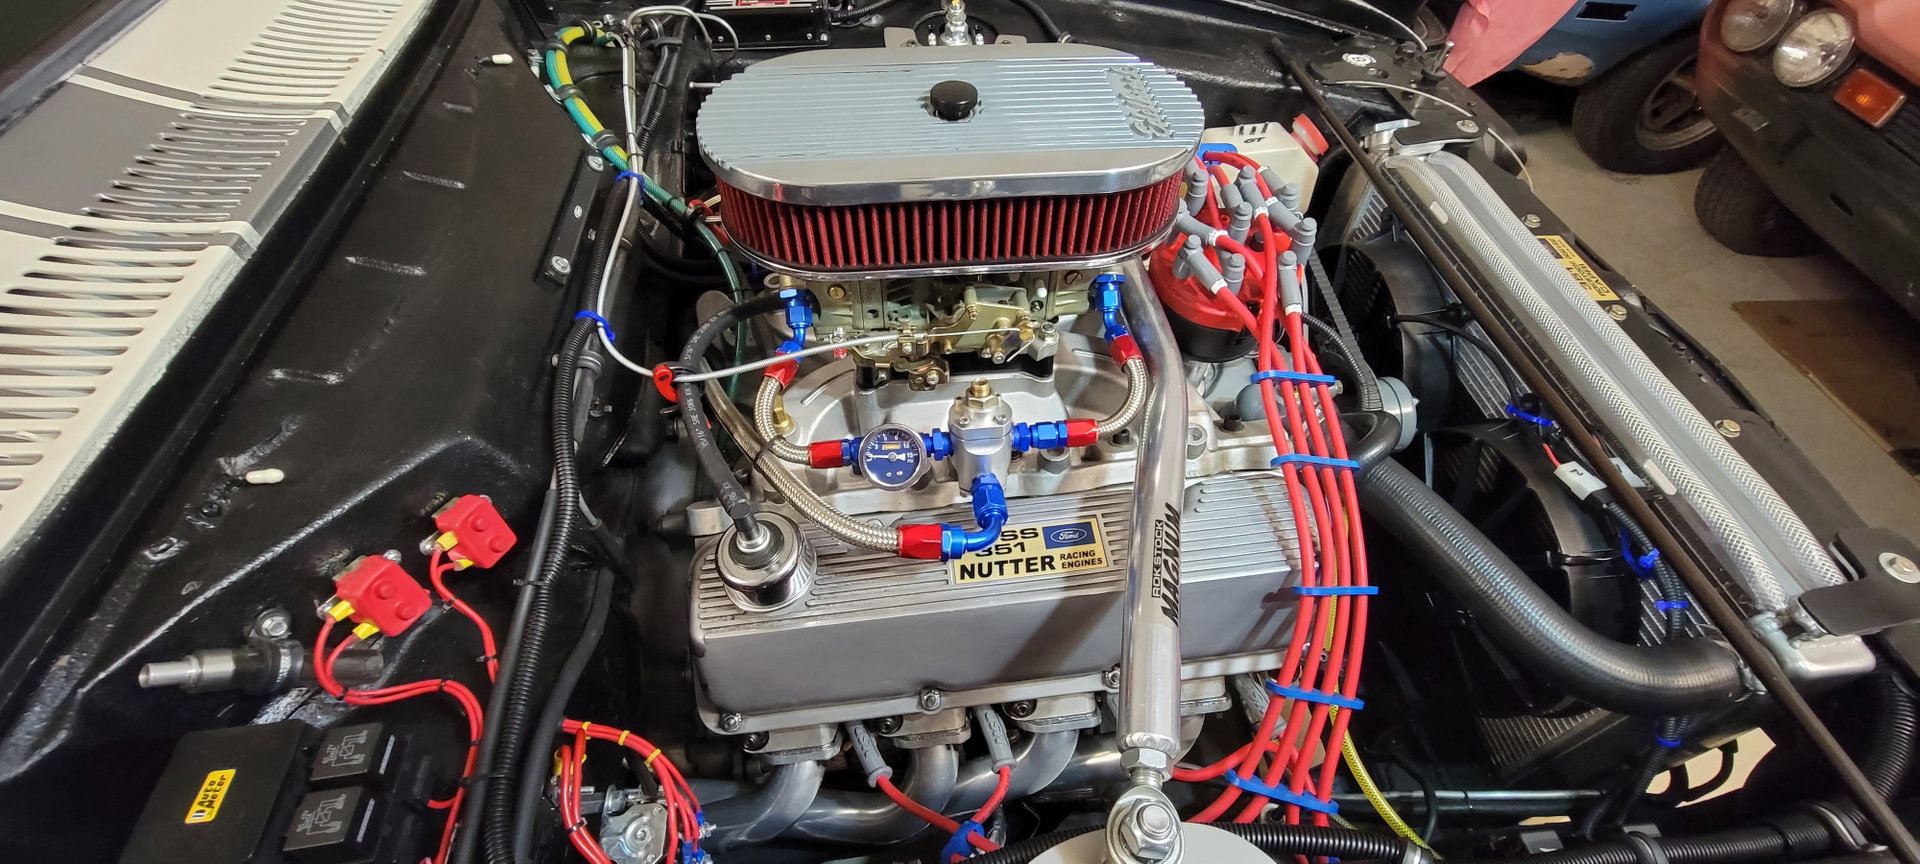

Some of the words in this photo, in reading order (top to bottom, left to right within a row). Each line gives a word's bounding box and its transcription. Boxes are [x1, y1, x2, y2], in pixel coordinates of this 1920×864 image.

[1578, 263, 1610, 294] CAPRI
[975, 541, 1026, 558] 351
[1060, 549, 1096, 561] RACING
[1154, 520, 1163, 566] STOCK
[959, 555, 1056, 581] NUTTER
[1061, 557, 1103, 569] ENGINES
[1160, 502, 1180, 628] MAGNUM
[1152, 567, 1161, 597] ROK
